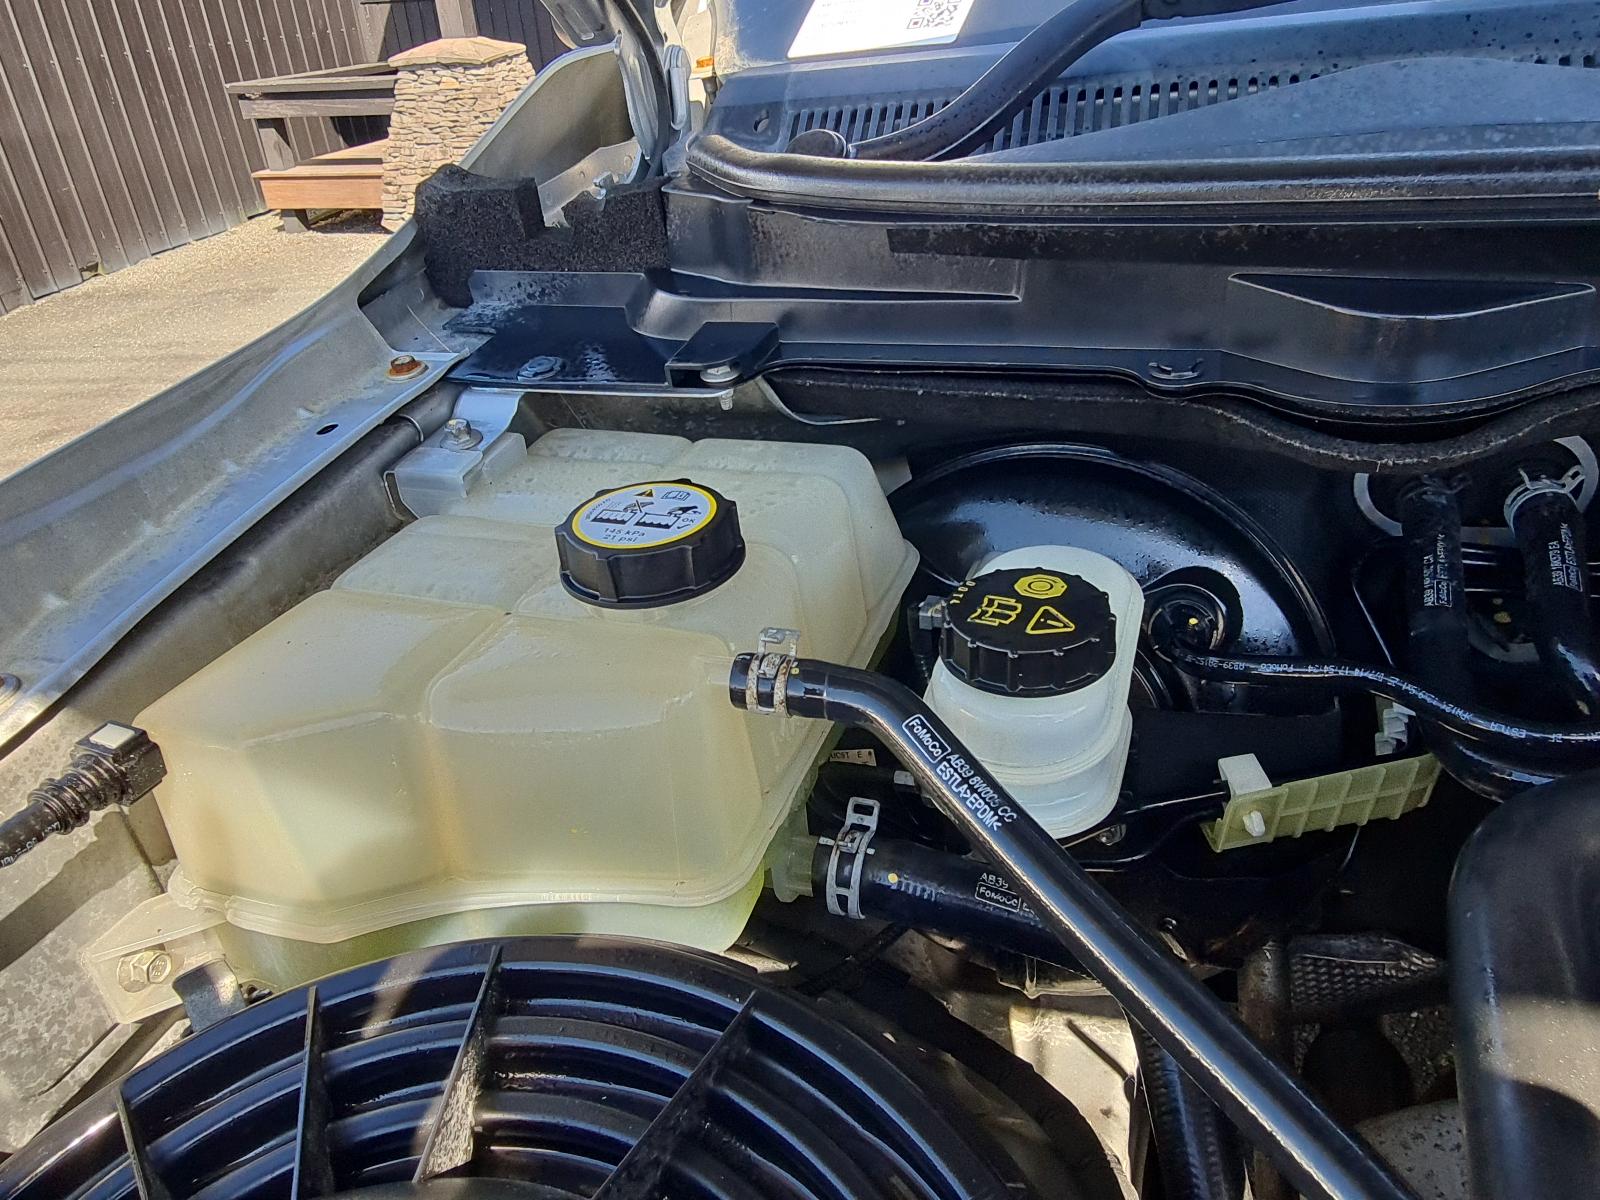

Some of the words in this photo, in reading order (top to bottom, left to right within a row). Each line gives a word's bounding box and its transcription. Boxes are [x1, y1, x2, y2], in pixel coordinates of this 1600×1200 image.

[603, 527, 622, 535] 145
[624, 528, 646, 537] kPa
[617, 535, 639, 543] psi
[908, 718, 942, 757] FoMoCo
[946, 753, 975, 778] AB39
[997, 805, 1018, 823] CC
